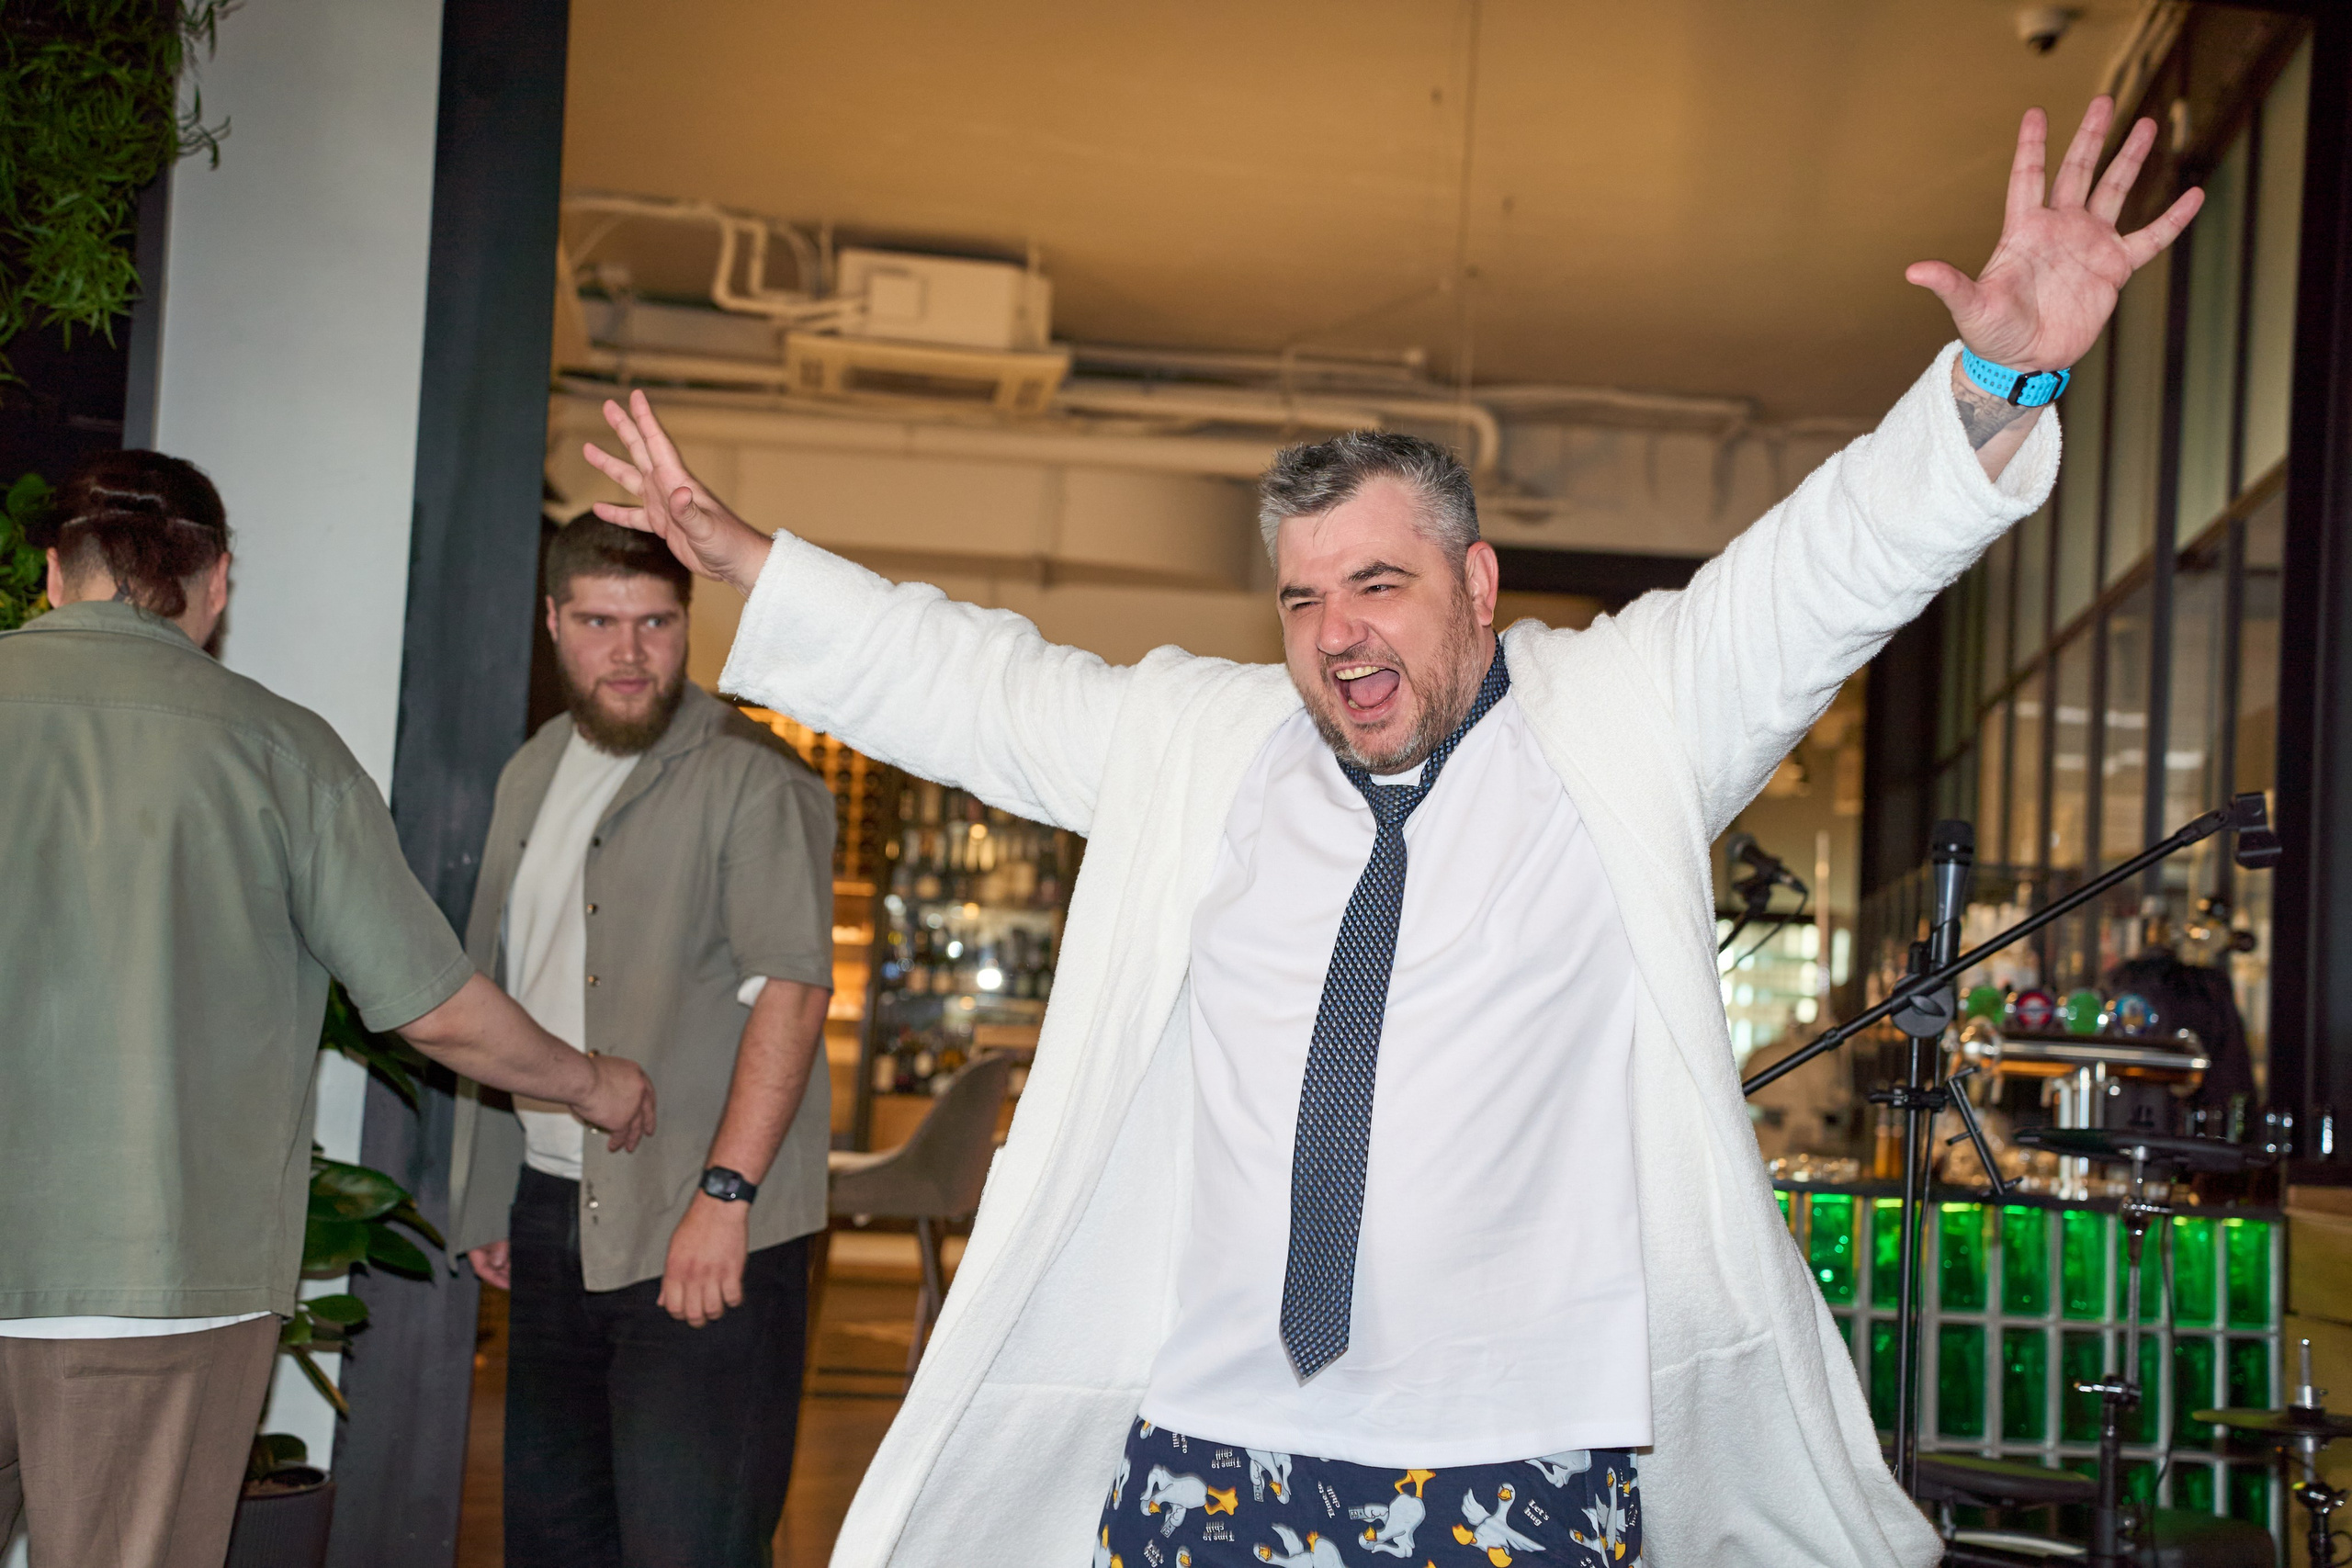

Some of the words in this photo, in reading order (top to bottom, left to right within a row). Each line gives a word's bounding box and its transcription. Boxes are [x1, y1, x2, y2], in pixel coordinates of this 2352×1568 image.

[1216, 1450, 1233, 1461] chill
[1211, 1461, 1220, 1469] to
[1221, 1458, 1241, 1469] Time
[1327, 1486, 1340, 1508] chill
[1322, 1495, 1336, 1518] Time
[1528, 1499, 1550, 1521] Let's
[1523, 1506, 1543, 1527] hug
[1205, 1524, 1225, 1533] chill
[1203, 1533, 1212, 1541] to
[1213, 1532, 1235, 1541] Time
